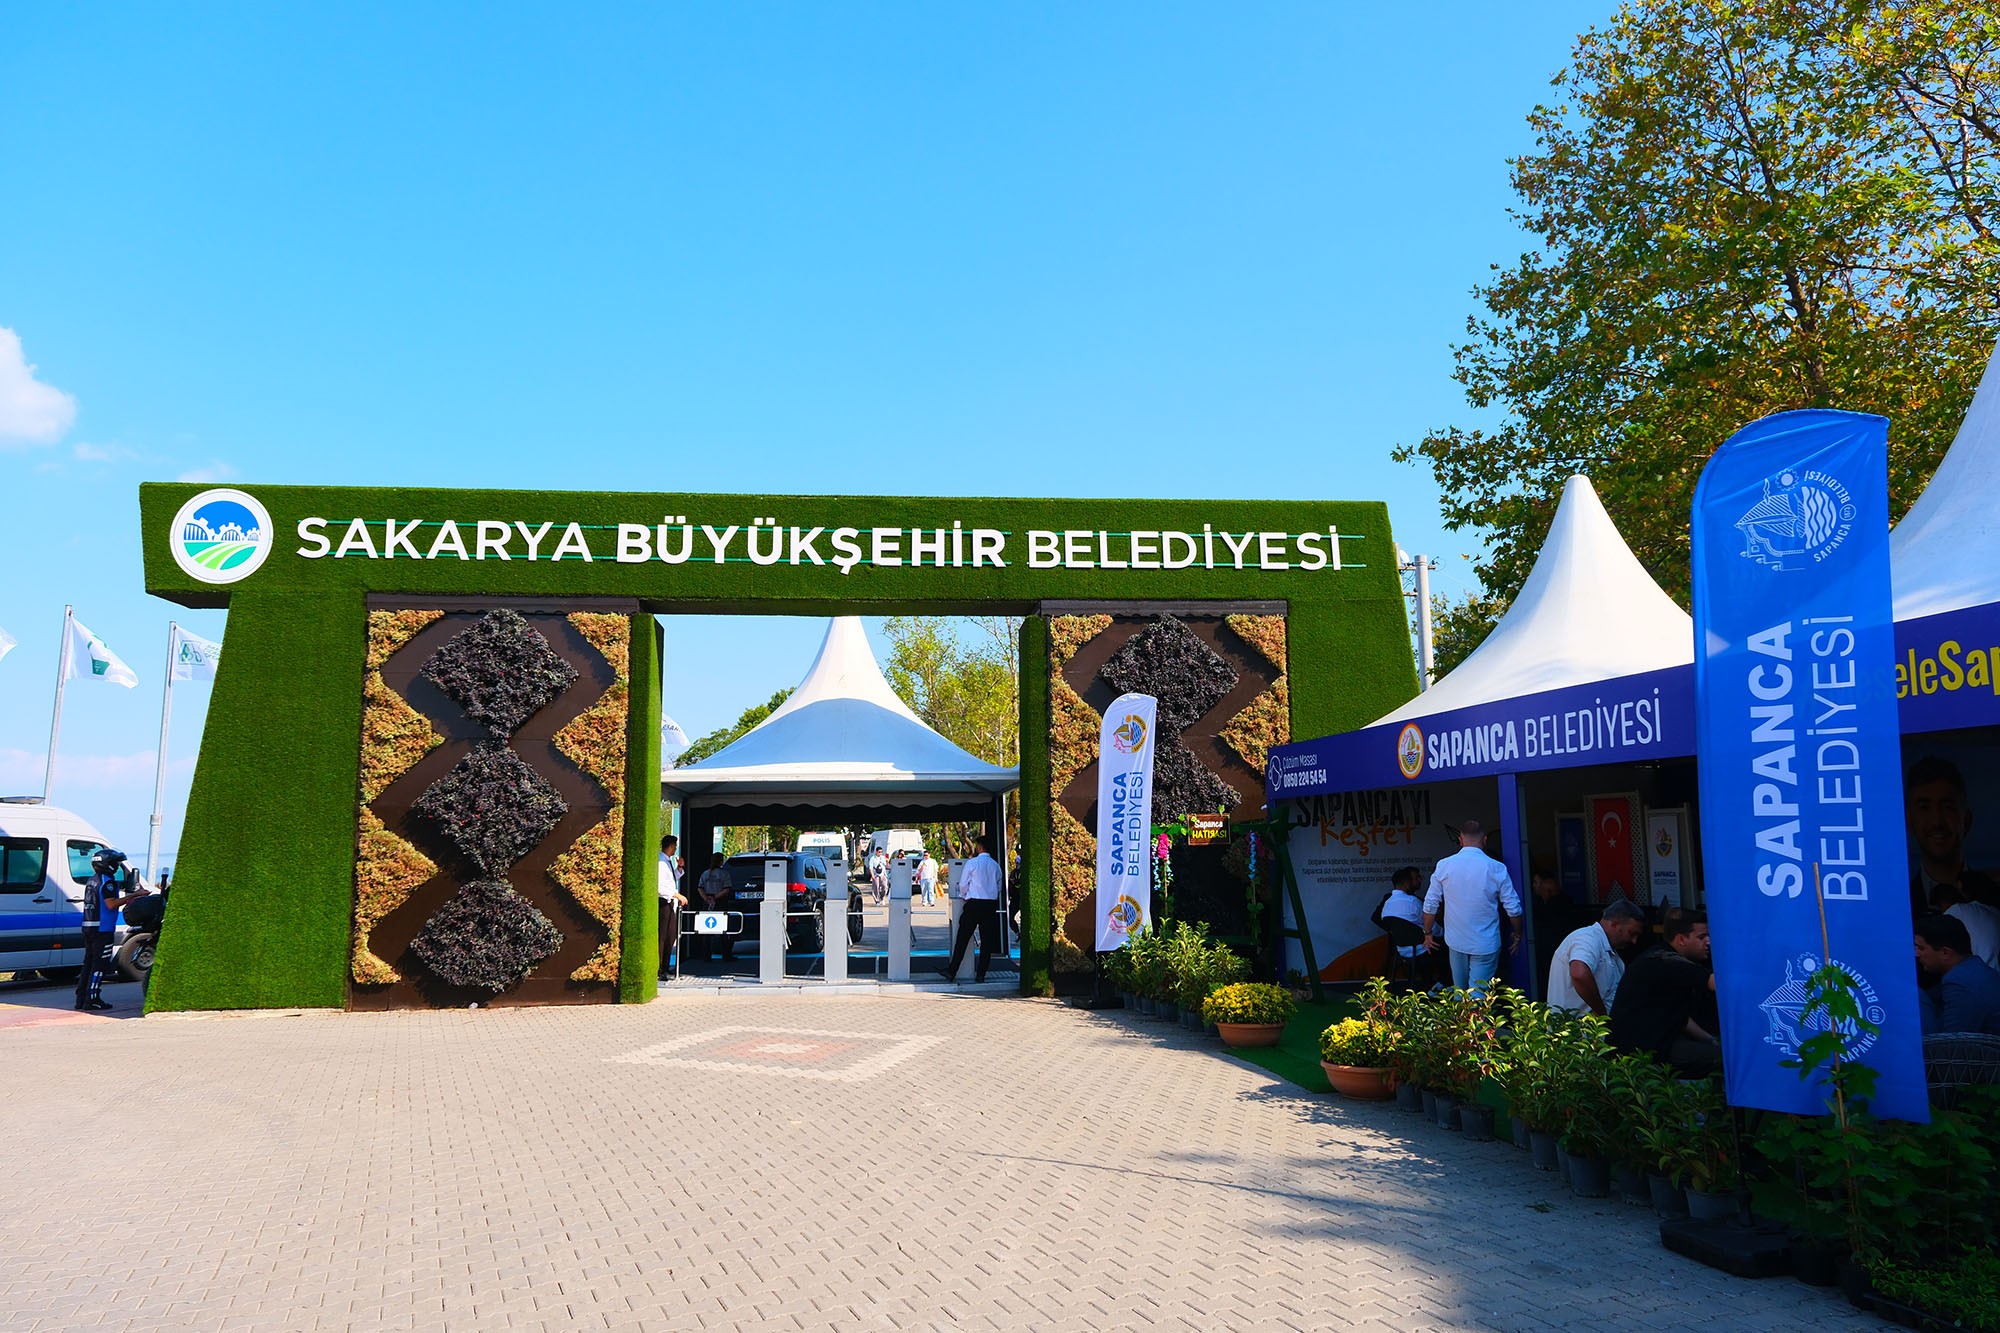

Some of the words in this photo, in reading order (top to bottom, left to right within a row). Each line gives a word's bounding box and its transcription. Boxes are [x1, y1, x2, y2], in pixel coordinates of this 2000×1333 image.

[1803, 469, 1851, 504] BELEDİYESİ
[295, 517, 594, 563] SAKARYA
[616, 515, 1007, 575] BÜYÜKŞEHİR
[1027, 523, 1342, 571] BELEDİYESİ
[1813, 524, 1851, 562] SAPANCA
[1428, 720, 1519, 769] SAPANCA
[1525, 687, 1662, 758] BELEDİYESİ
[1802, 615, 1868, 900] BELEDİYESİ
[1283, 772, 1298, 788] 0850
[1298, 771, 1309, 786] 224
[1310, 769, 1318, 785] 54
[1318, 768, 1327, 784] 54
[1747, 621, 1803, 899] SAPANCA
[1111, 772, 1126, 875] SAPANCA
[1127, 771, 1143, 876] BELEDİYESİ
[1320, 815, 1416, 856] Keşfet
[1839, 1030, 1878, 1063] SAPANC
